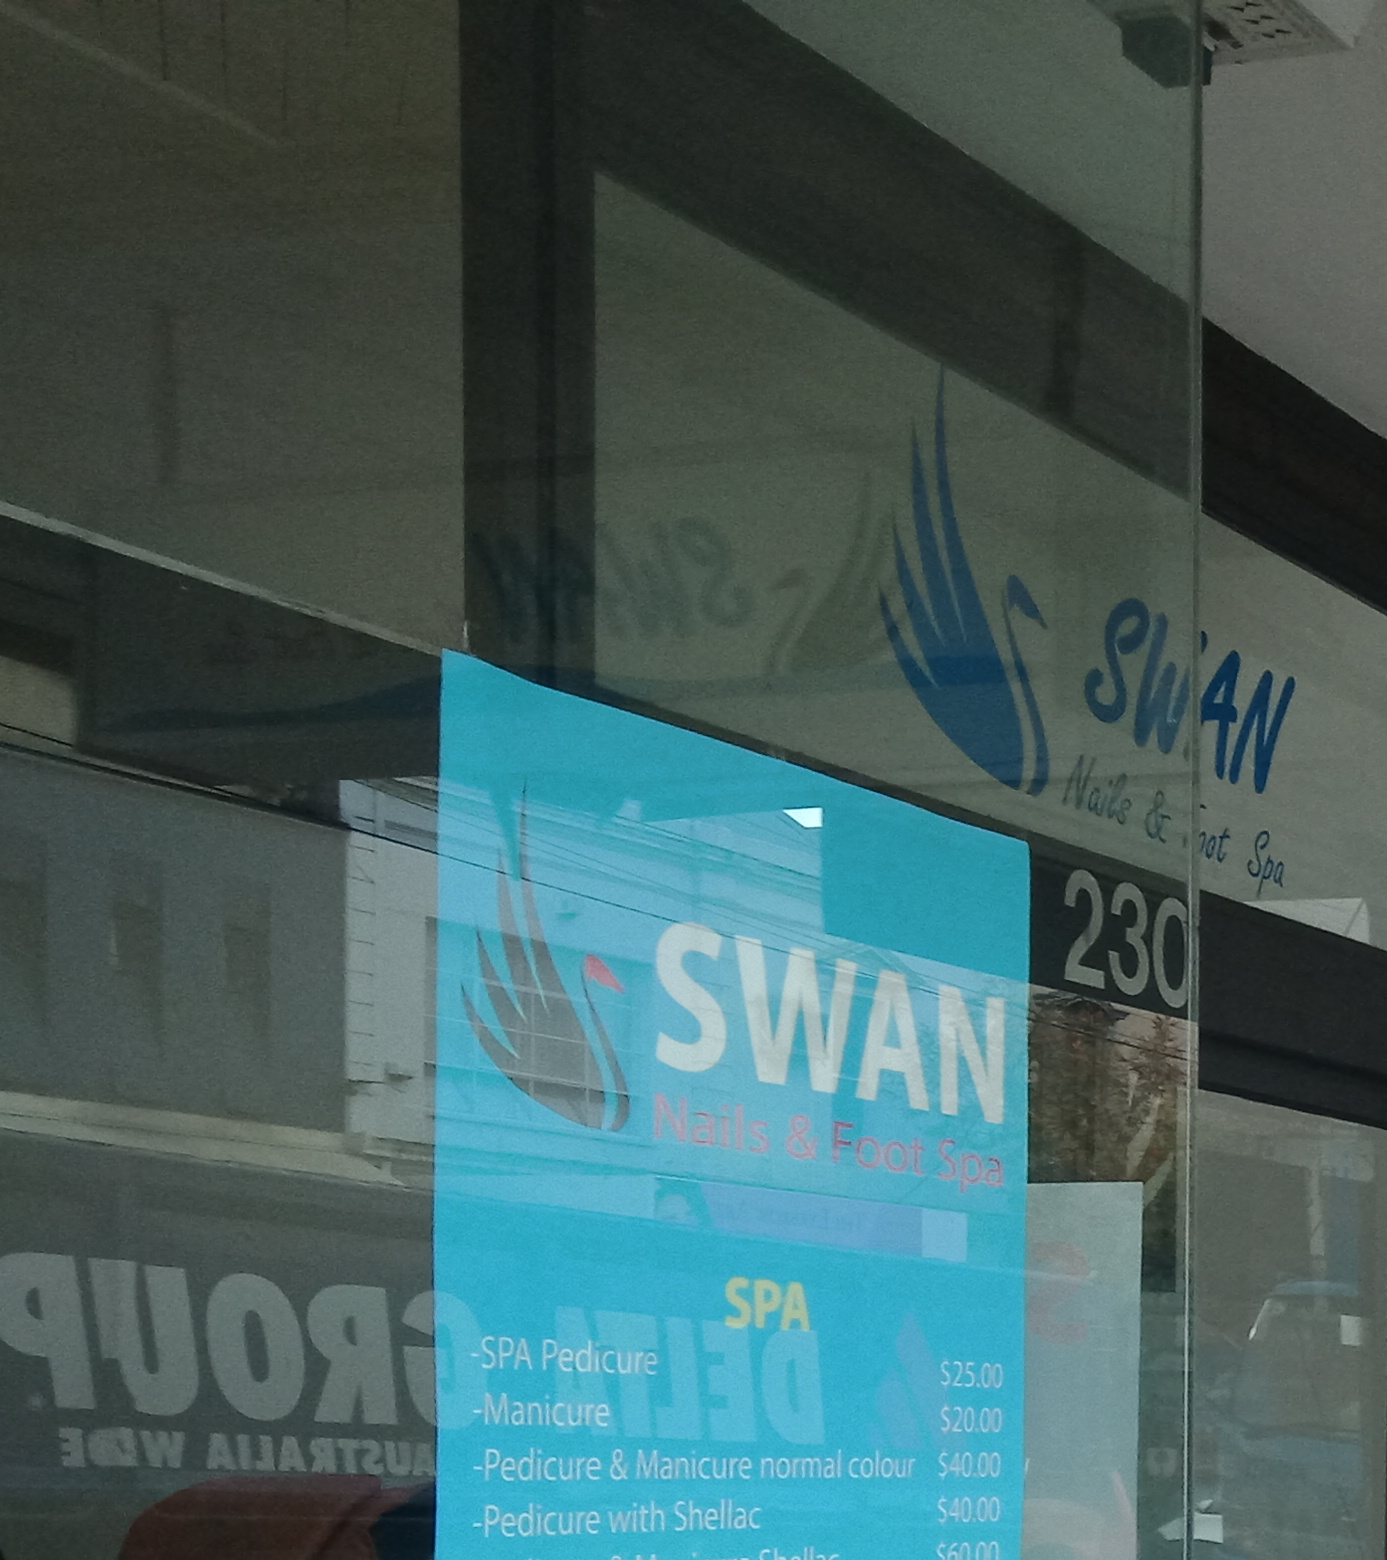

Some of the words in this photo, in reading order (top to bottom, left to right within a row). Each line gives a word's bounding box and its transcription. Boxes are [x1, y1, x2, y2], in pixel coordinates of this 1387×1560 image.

[1084, 598, 1295, 794] SWAN
[1062, 753, 1132, 826] Nails
[1145, 791, 1171, 844] &
[1247, 830, 1285, 896] Spa
[1063, 868, 1188, 1008] 230
[655, 921, 1004, 1124] SWAN
[653, 1092, 770, 1154] Nails
[786, 1114, 818, 1161] &
[831, 1119, 924, 1175] Foot
[937, 1138, 1004, 1193] Spa
[725, 1276, 810, 1331] SPA
[542, 1339, 658, 1375] Pedicure
[940, 1361, 1003, 1389] $25.00
[940, 1407, 1002, 1434] $20.00
[610, 1450, 628, 1479] &
[636, 1450, 752, 1479] Manicure
[761, 1451, 841, 1478] normal
[848, 1450, 915, 1478] colour
[938, 1452, 1000, 1479] $40.00
[608, 1501, 667, 1534] with
[674, 1500, 761, 1532] Shellac
[937, 1497, 1000, 1524] $40.00
